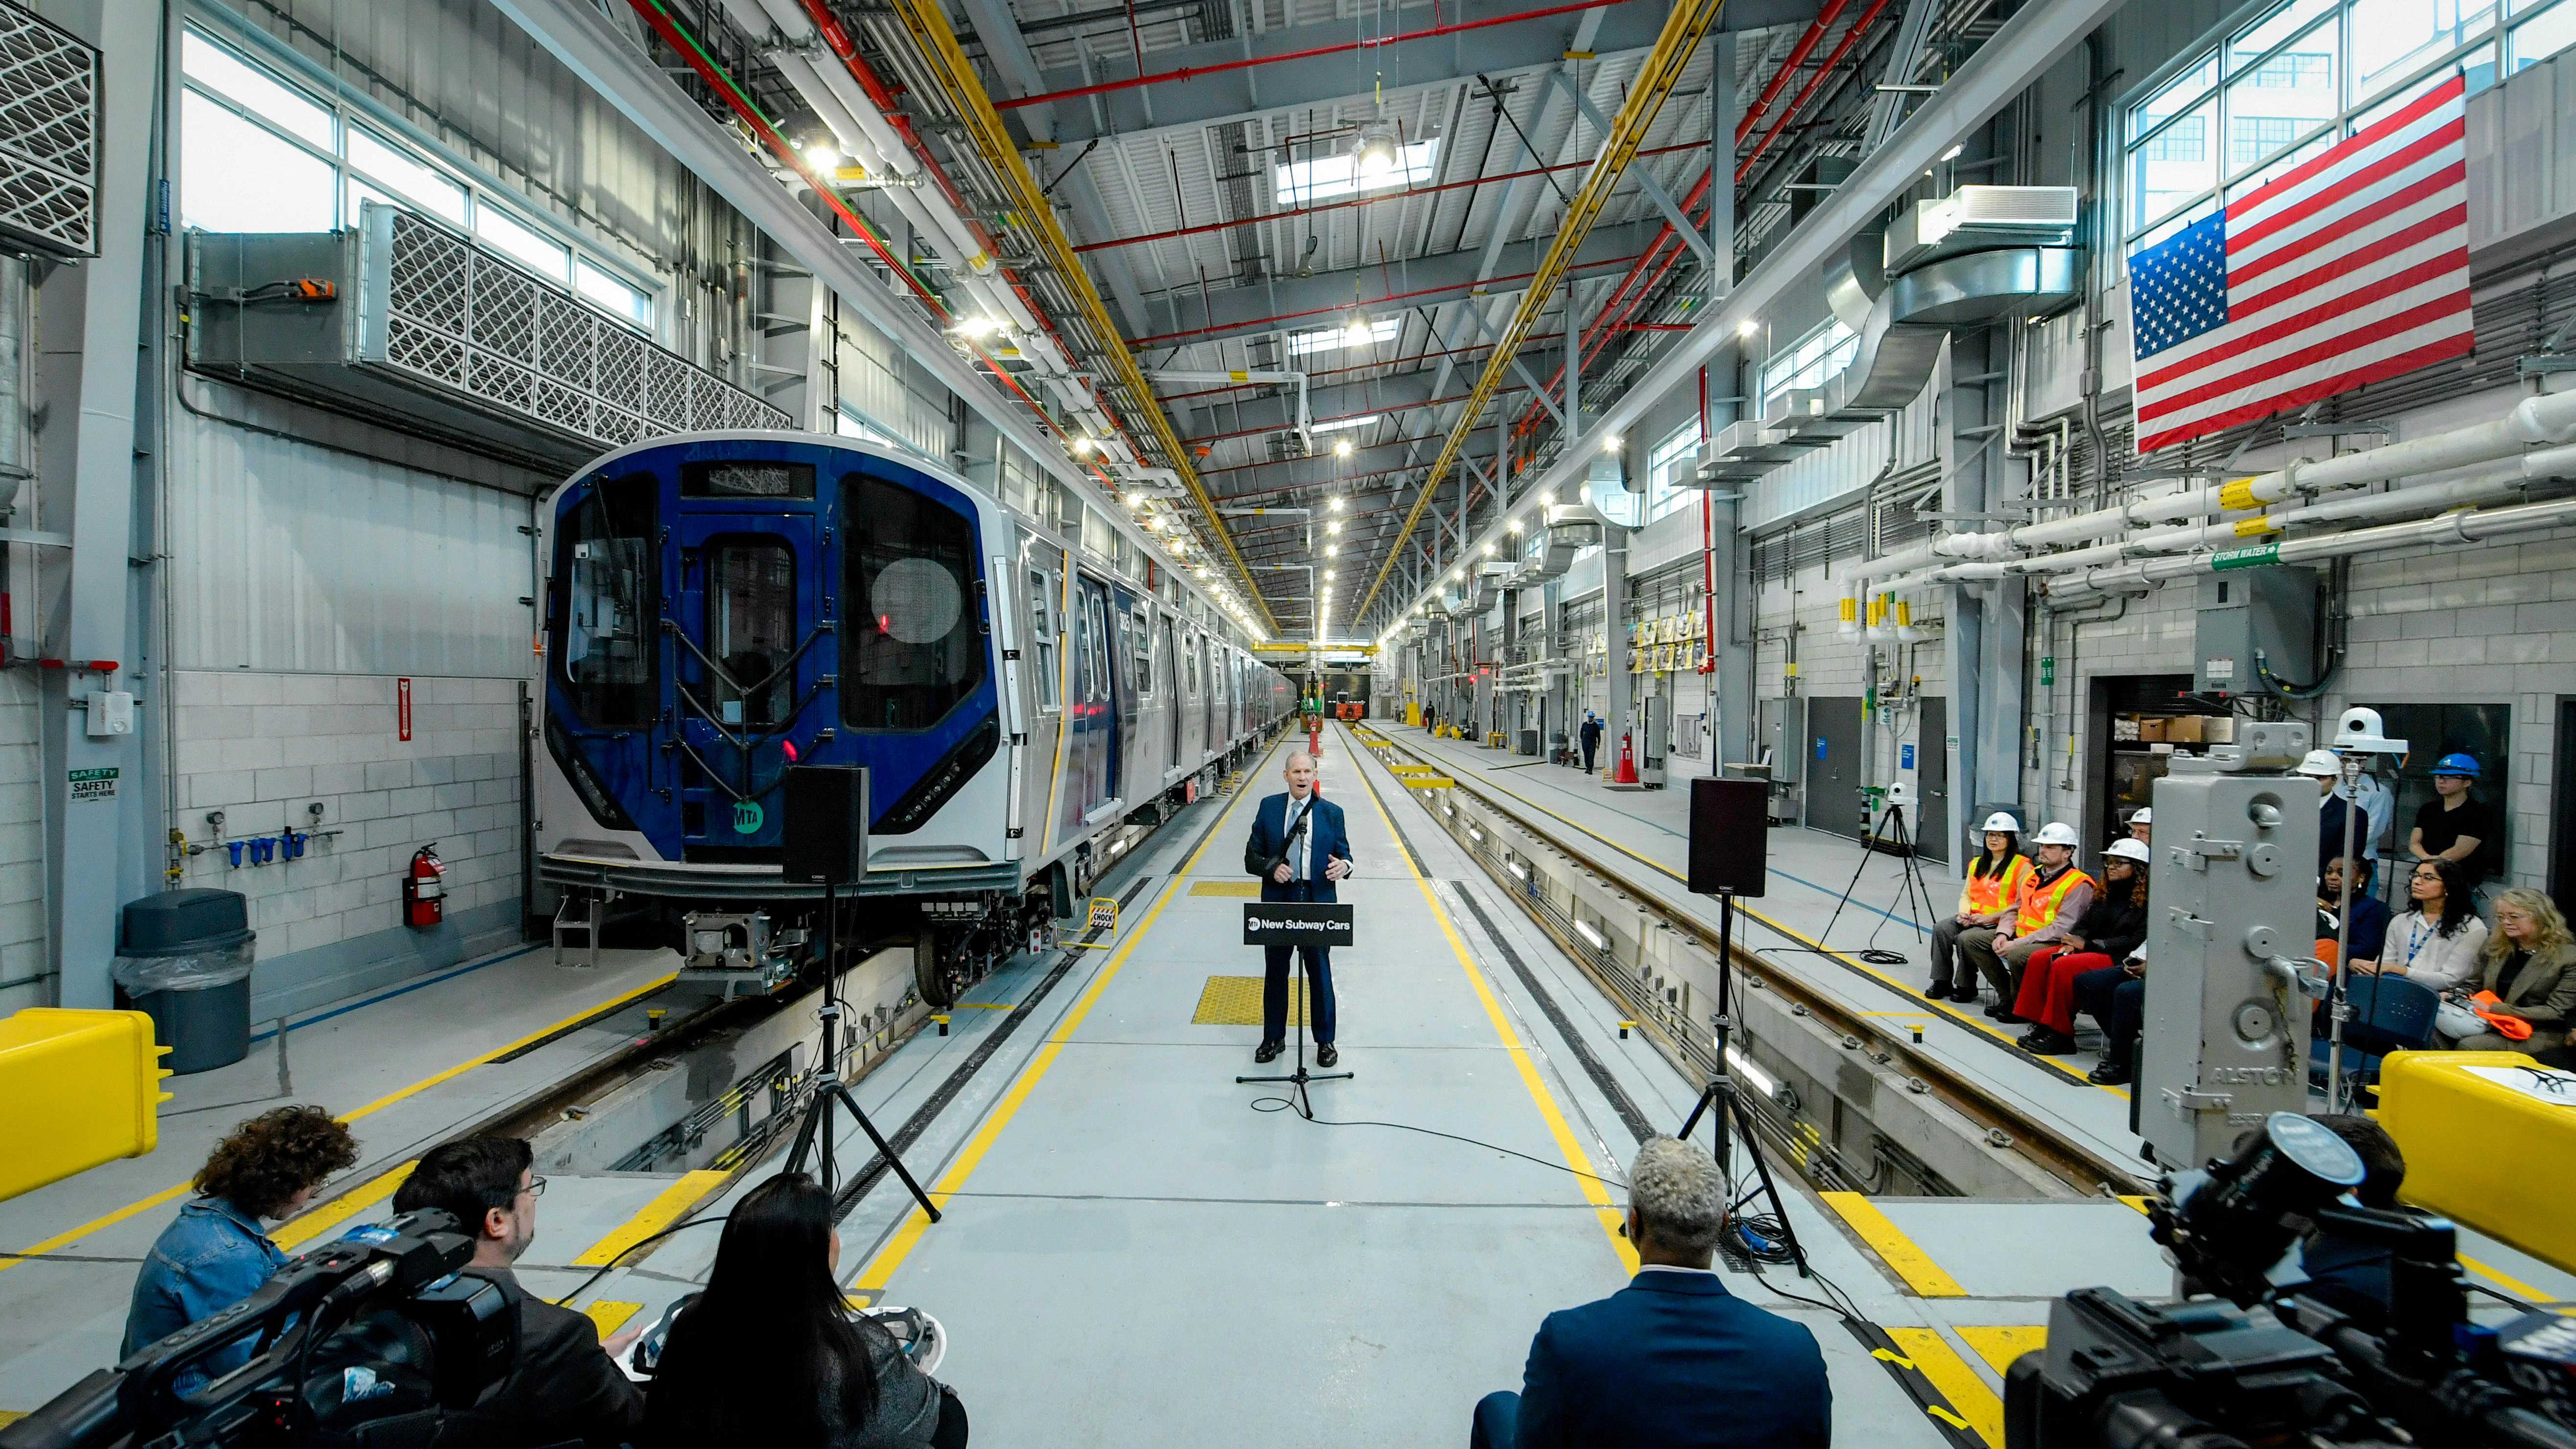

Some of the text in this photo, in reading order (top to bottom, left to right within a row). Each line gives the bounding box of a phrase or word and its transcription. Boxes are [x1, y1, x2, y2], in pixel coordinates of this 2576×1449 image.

[2213, 546, 2267, 562] STORM WATER
[71, 769, 116, 780] SAFETY
[74, 780, 114, 792] SAFETY
[734, 807, 758, 826] MTA
[1094, 913, 1112, 922] CHOCK
[1261, 919, 1284, 929] New
[1285, 919, 1325, 931] Subway
[1326, 920, 1351, 930] Cars
